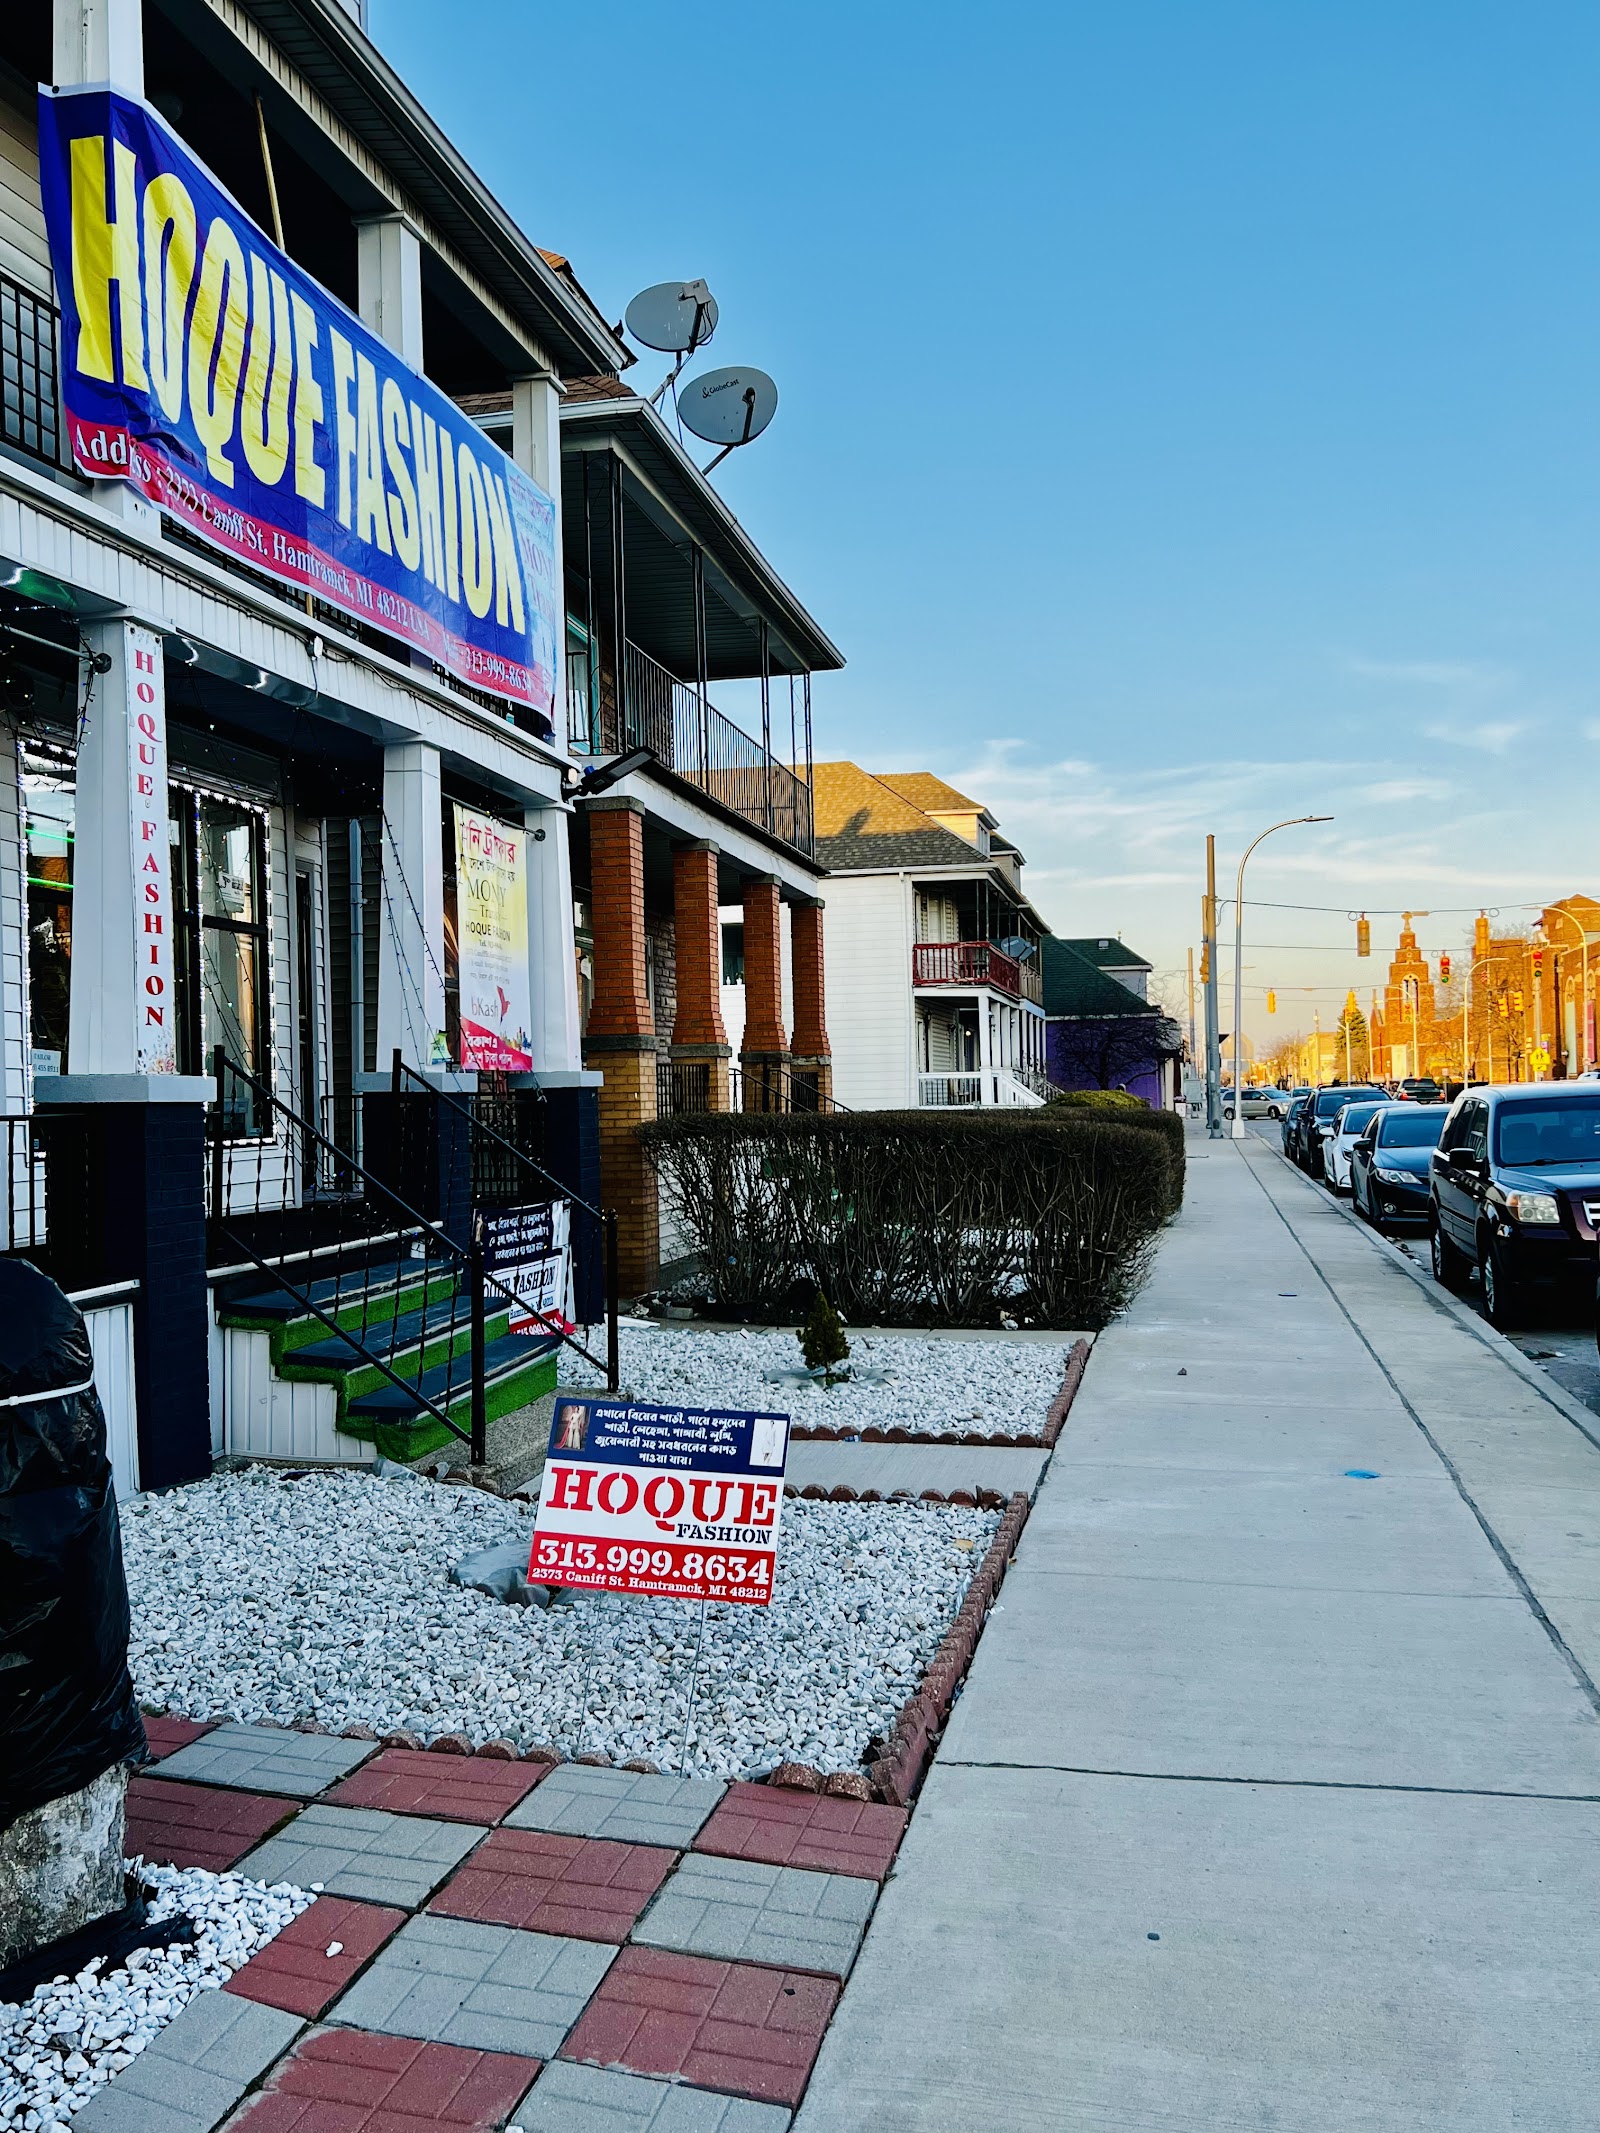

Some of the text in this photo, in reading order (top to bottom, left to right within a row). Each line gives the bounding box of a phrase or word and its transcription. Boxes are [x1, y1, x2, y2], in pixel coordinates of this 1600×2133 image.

[70, 135, 527, 635] HOQUE FASHION
[201, 492, 244, 543] Caniff
[245, 520, 268, 556] St.
[272, 531, 355, 604] Hamtramck,
[355, 576, 375, 611] MI
[376, 588, 410, 630] 48212
[409, 610, 431, 642] USA
[134, 648, 166, 1028] HOQUE FASHION
[465, 920, 492, 936] HOQUE
[470, 995, 499, 1018] bKash
[545, 1466, 778, 1532] HOQUE
[675, 1522, 773, 1545] FASHION
[531, 1567, 768, 1600] 2373 Caniff St. Hamtramck, MI 48212
[537, 1538, 770, 1585] 313.999.8634
